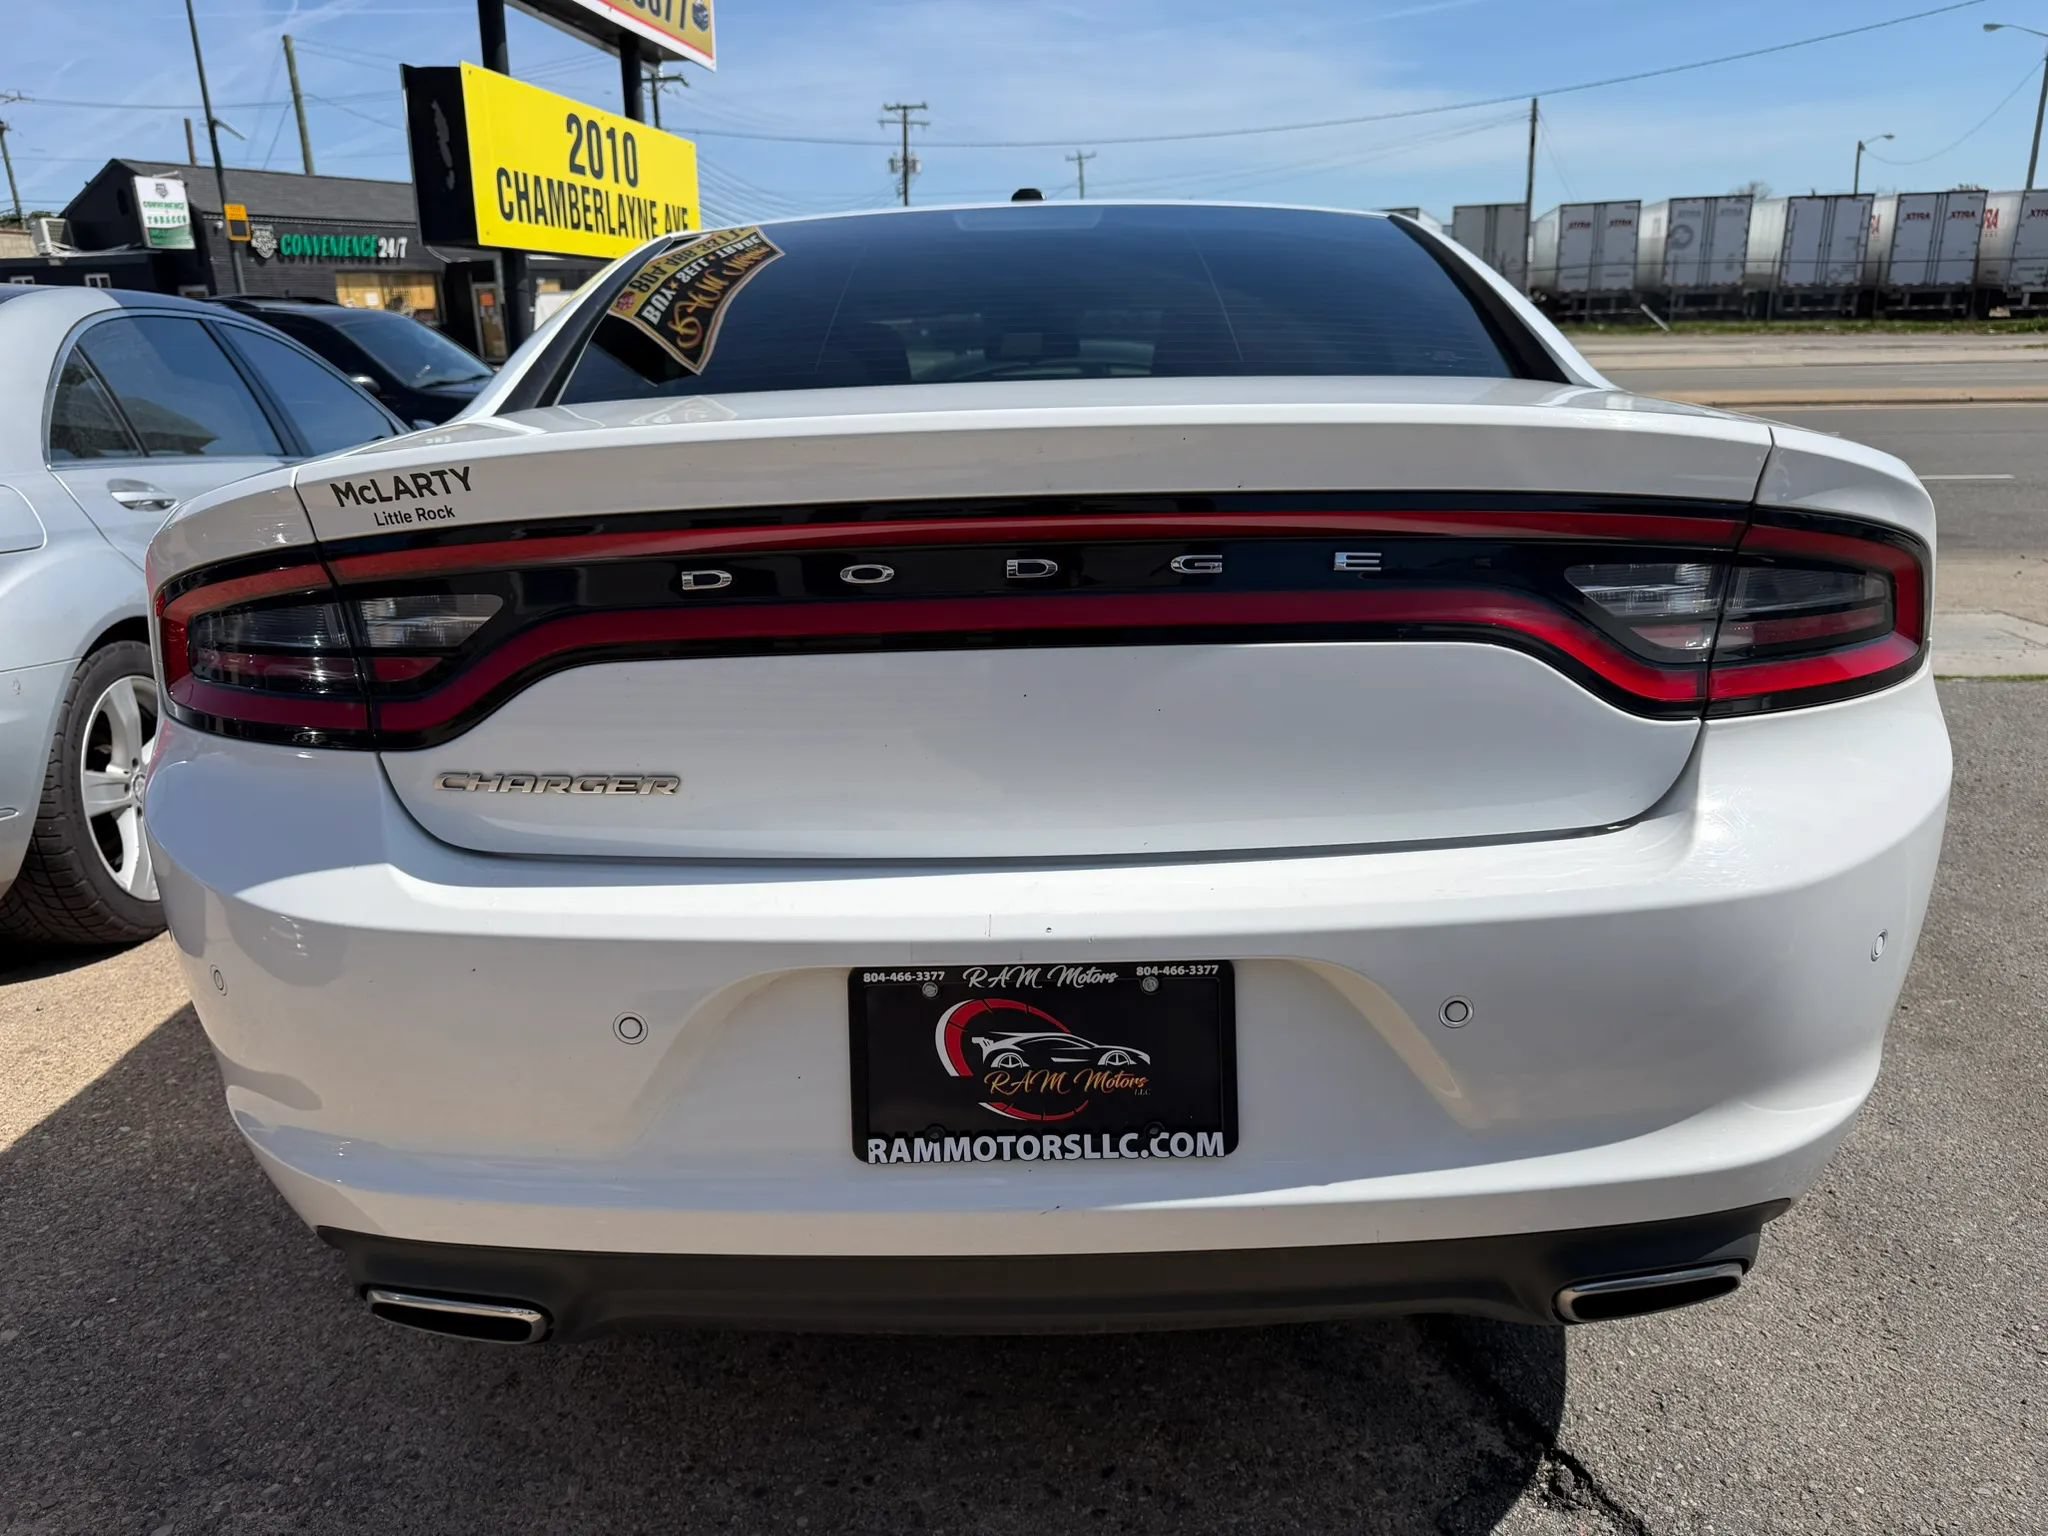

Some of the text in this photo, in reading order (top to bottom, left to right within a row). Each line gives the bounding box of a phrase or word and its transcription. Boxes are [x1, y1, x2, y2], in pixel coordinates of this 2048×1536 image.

[566, 113, 639, 188] 2010
[496, 167, 689, 240] CHAMBERLAYNE AVE
[147, 215, 187, 224] TOBACCO
[280, 234, 379, 257] CONVENIENCE
[378, 236, 408, 258] 24/7
[330, 466, 472, 508] McLARTY
[374, 504, 456, 527] Little Rock
[682, 551, 1382, 590] DODGE
[433, 772, 681, 796] CHARGER
[863, 965, 1219, 989] 804-466-3377 RAM Motors 804-466-3377
[984, 1068, 1150, 1096] RAM Motors
[868, 1131, 1225, 1163] RAMMOTORSLLC.COM
